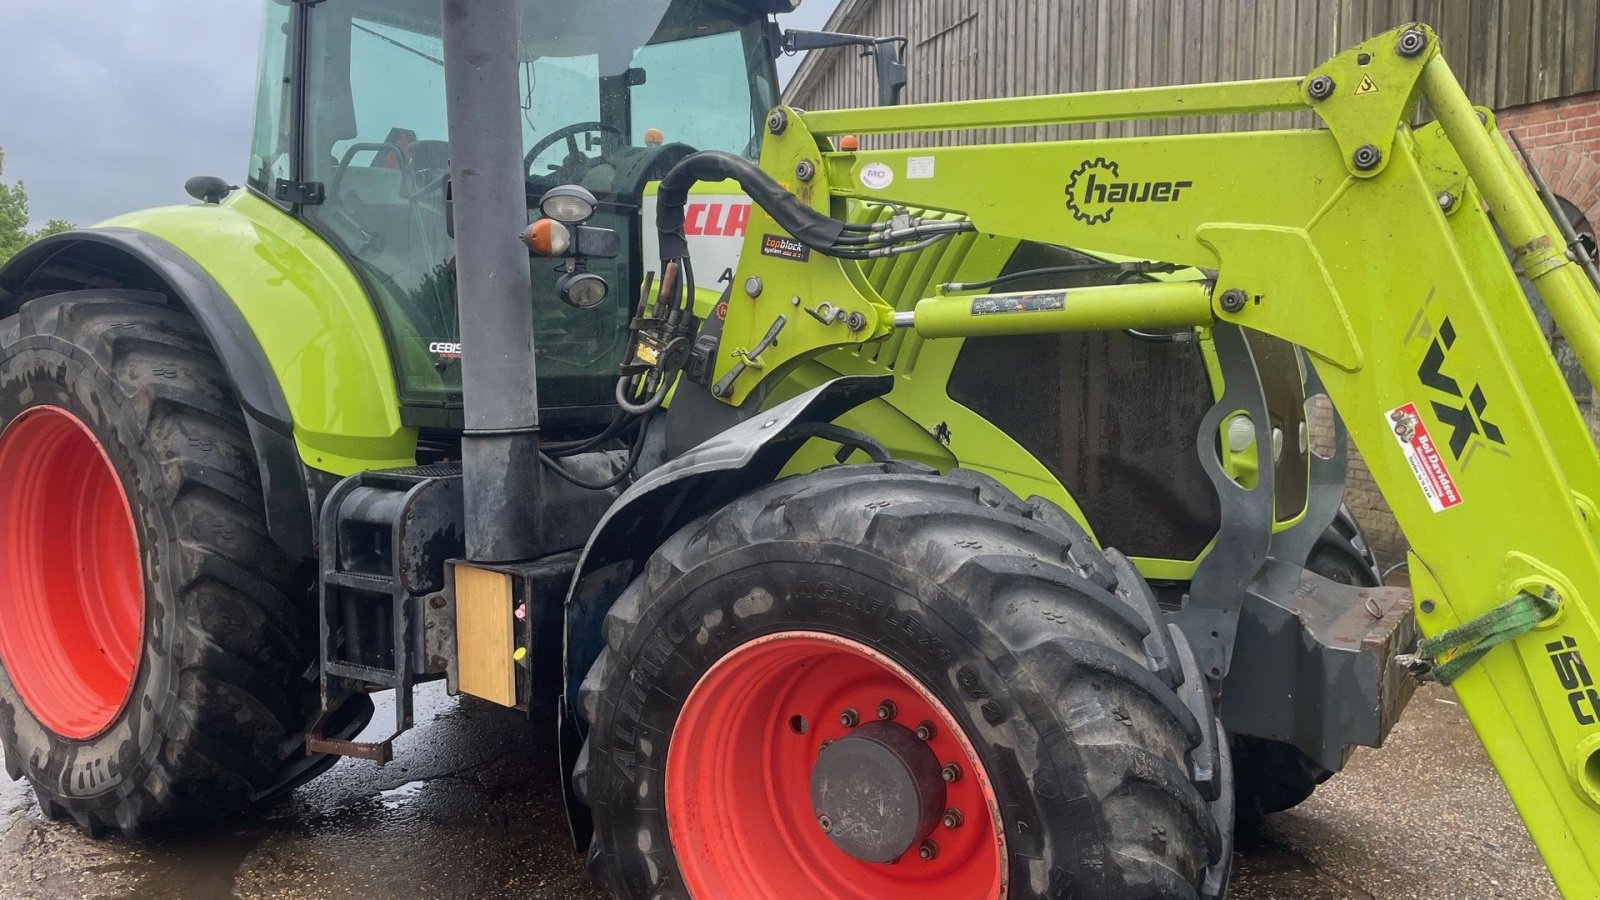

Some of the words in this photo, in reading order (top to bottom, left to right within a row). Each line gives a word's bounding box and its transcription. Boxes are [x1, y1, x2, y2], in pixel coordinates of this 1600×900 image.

[1084, 174, 1193, 204] hauer
[765, 237, 803, 252] topblock
[429, 341, 462, 354] CEBIS
[1428, 454, 1457, 503] Davidsen
[612, 601, 700, 784] ALLIANCE
